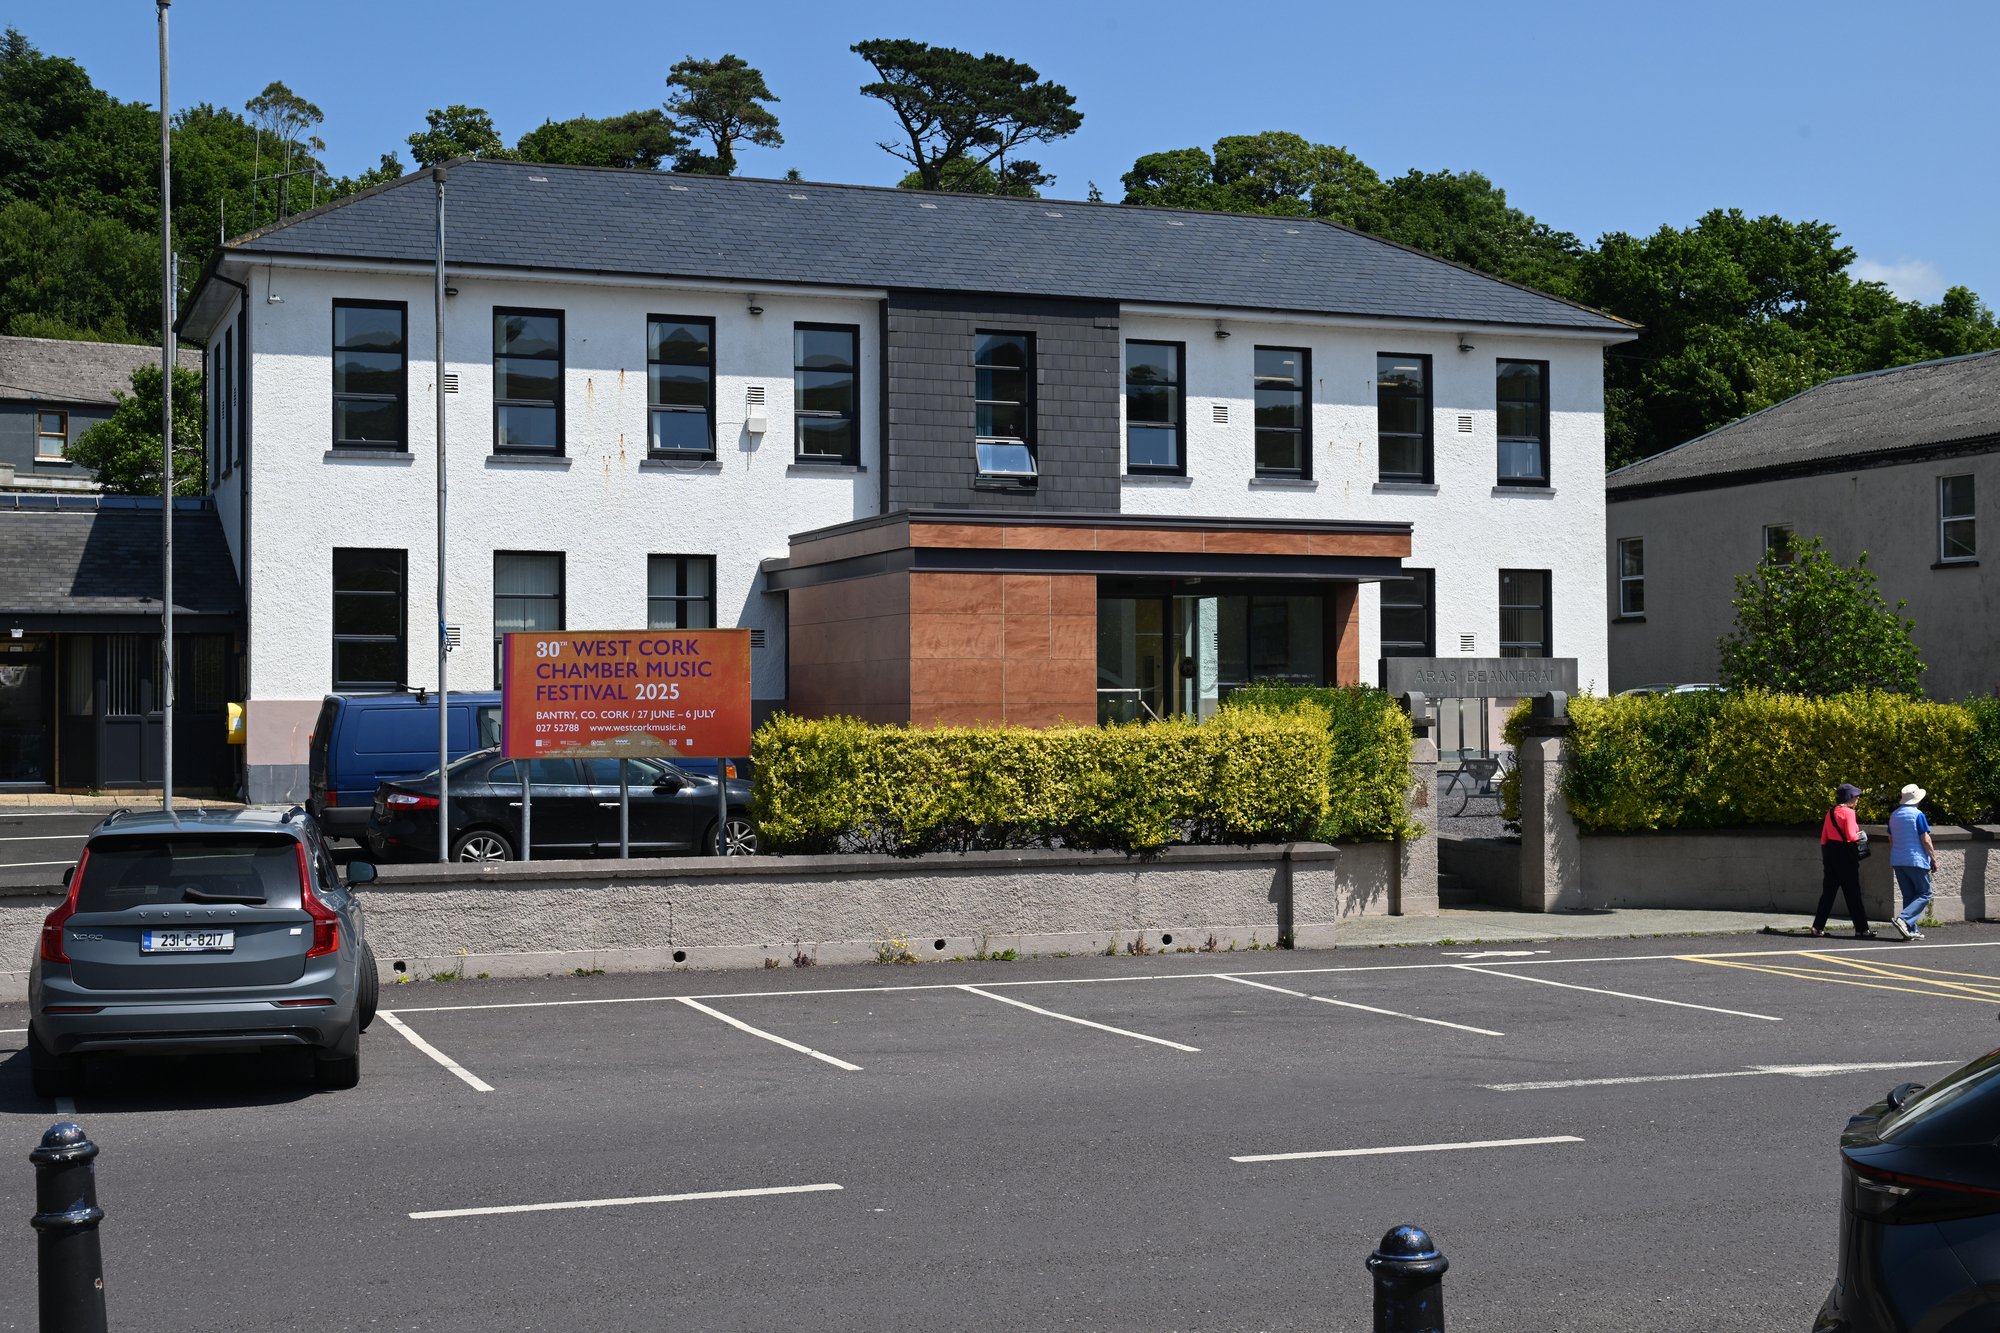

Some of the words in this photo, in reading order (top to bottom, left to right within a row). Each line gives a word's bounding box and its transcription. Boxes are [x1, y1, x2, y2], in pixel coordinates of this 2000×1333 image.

[572, 640, 631, 657] WEST
[638, 639, 700, 656] CORK
[536, 662, 639, 679] CHAMBER
[646, 661, 712, 678] MUSIC
[1414, 667, 1457, 684] ÁRAS
[1467, 667, 1554, 684] BEANNTRAÍ
[536, 684, 628, 701] FESTIVAL
[634, 683, 680, 700] 2025
[536, 711, 578, 720] BANTRY,
[580, 710, 598, 719] CO.
[600, 710, 629, 719] CORK
[631, 710, 636, 719] /
[637, 710, 648, 719] 27
[650, 710, 675, 720] JUNE
[685, 710, 691, 718] 6
[693, 710, 716, 720] JULY
[535, 724, 551, 732] 027
[554, 723, 580, 732] 52788
[589, 723, 686, 732] www.westcorkmusic.ie
[139, 910, 237, 918] VOLVO
[71, 933, 103, 942] XC90
[161, 933, 223, 947] 231-C-8217
